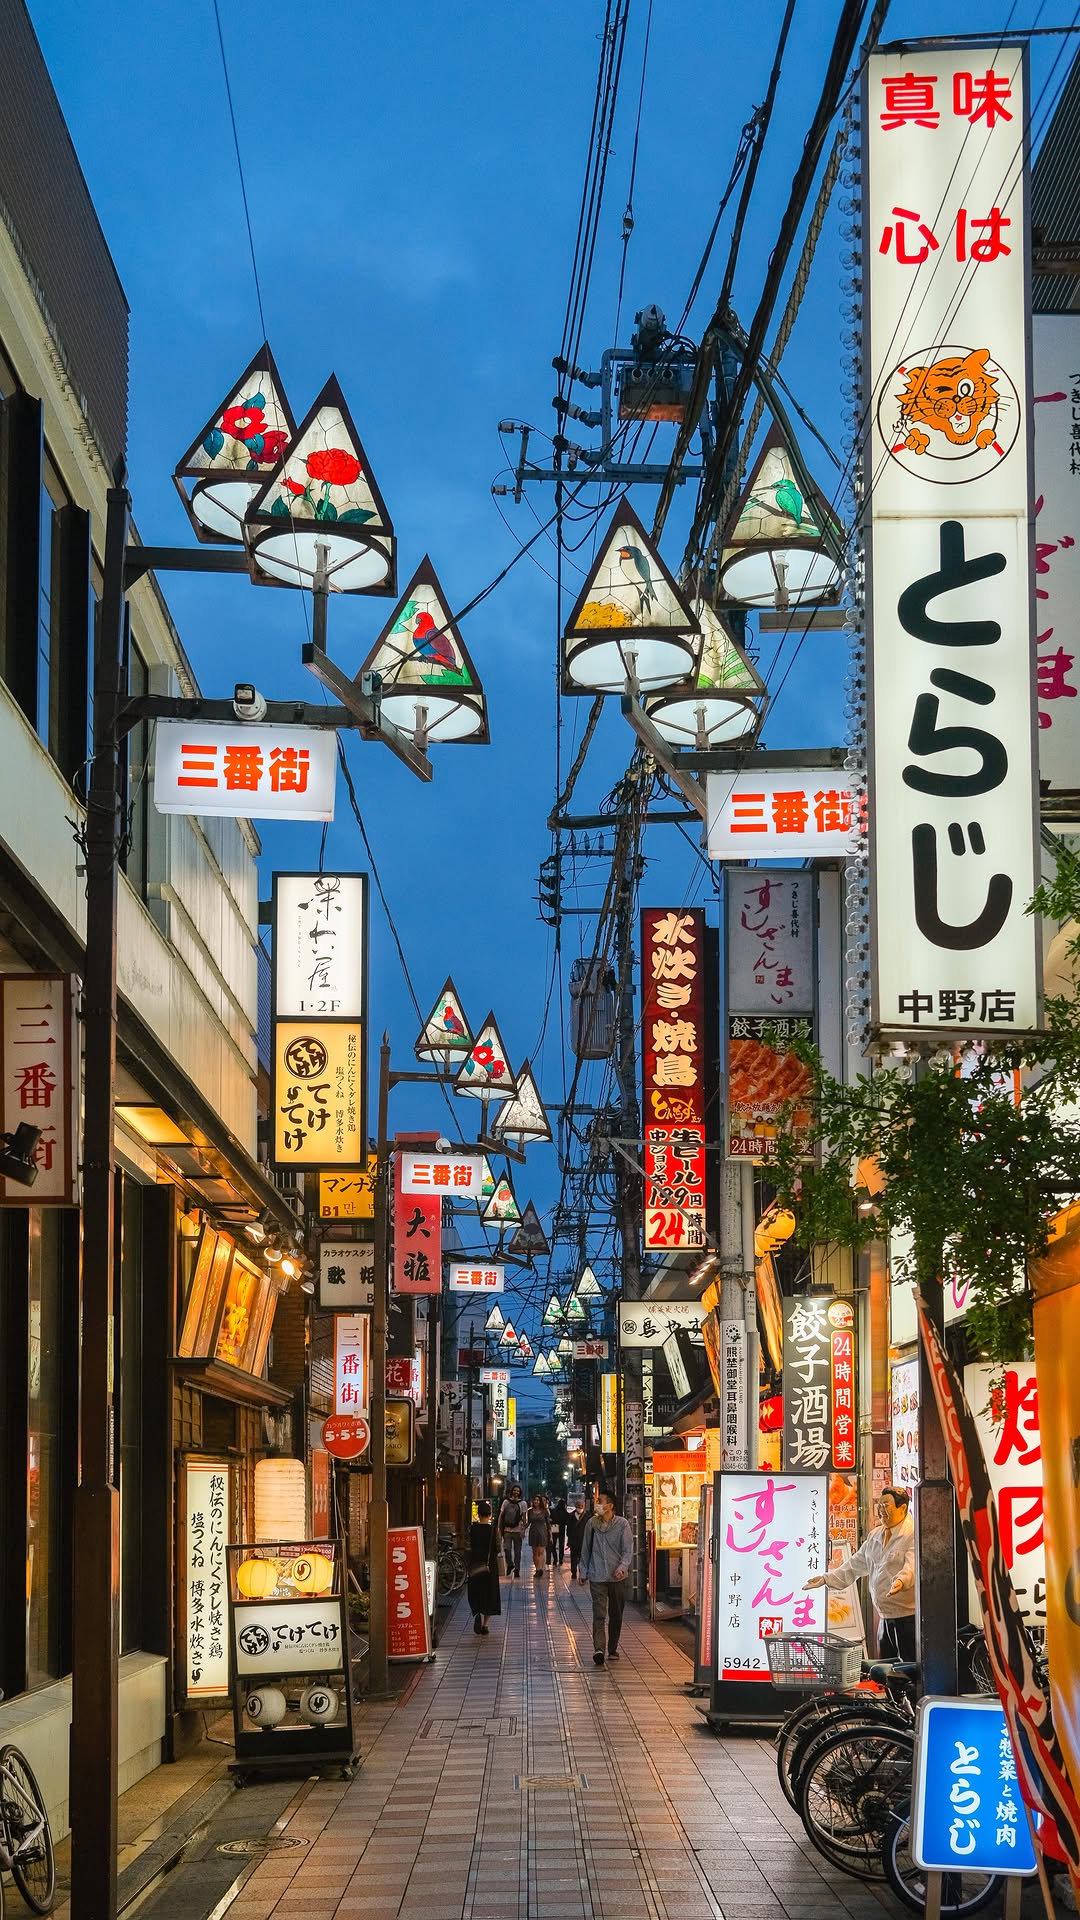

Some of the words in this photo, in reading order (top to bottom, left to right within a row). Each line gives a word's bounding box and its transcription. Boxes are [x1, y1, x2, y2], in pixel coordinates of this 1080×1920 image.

[897, 520, 1014, 952] とらじ
[177, 744, 311, 794] 三番街
[730, 790, 868, 835] 三番街
[790, 882, 800, 938] つきじ喜代村
[741, 879, 795, 1005] すしざんまい
[651, 912, 698, 1087] 水炊き・焼鳥
[898, 989, 1016, 1024] 中野店
[730, 1017, 813, 1039] 餃子酒場
[335, 1066, 345, 1098] 塩つくね
[335, 1109, 345, 1153] 博多水炊き
[649, 1129, 668, 1185] 中ジョッキ
[670, 1128, 702, 1186] 生ビール
[731, 1139, 813, 1154] 24時間業
[411, 1163, 473, 1187] 三番街
[649, 1187, 703, 1208] 199円
[322, 1206, 339, 1216] B1
[403, 1207, 431, 1282] 大雅
[456, 1271, 497, 1286] 三番街
[341, 1327, 360, 1404] 三番街
[484, 1371, 507, 1380] 三番街
[576, 1345, 604, 1355] 三番街
[787, 1302, 831, 1470] 餃子酒場
[833, 1336, 853, 1462] 24時間営業
[191, 1512, 205, 1569] 塩つくね
[807, 1488, 820, 1570] つきじ喜代村
[189, 1580, 205, 1666] 博多水炊き
[727, 1572, 742, 1628] 中野店
[271, 1620, 340, 1643] てけてけ
[949, 1741, 982, 1856] とらじ
